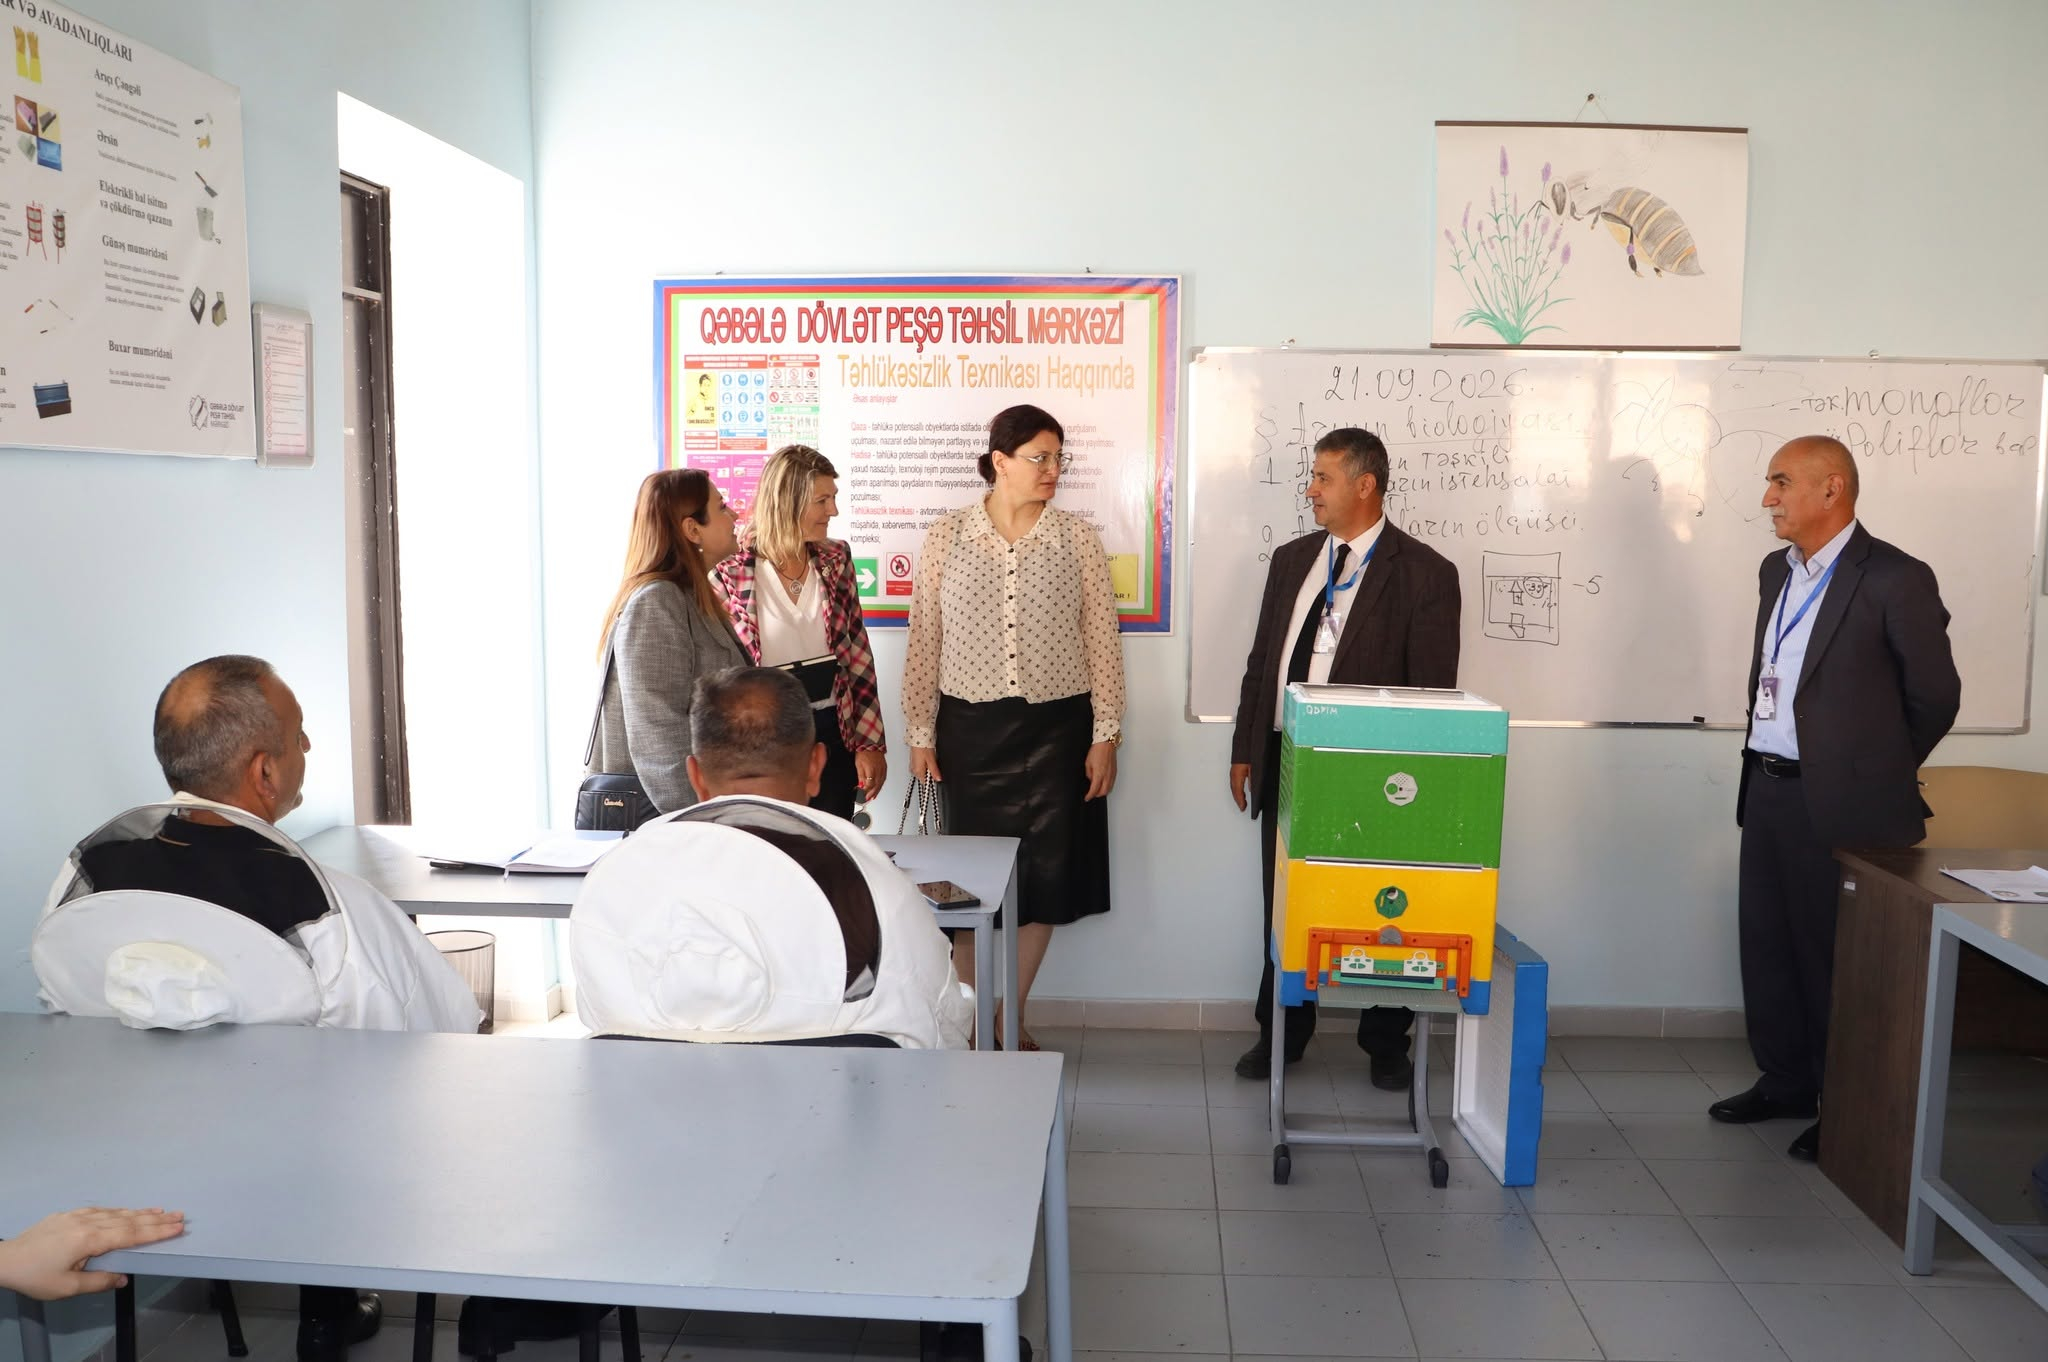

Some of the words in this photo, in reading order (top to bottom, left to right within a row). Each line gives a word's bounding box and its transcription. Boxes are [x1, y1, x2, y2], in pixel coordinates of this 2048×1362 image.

[39, 8, 133, 62] AVADANLIQLARI
[102, 234, 126, 253] Günəş
[108, 339, 130, 354] Buxar
[700, 306, 787, 346] QƏBƏLƏ
[797, 300, 882, 344] DÖVLƏT
[886, 306, 943, 353] PEŞƏ
[947, 300, 1023, 344] TƏHSİL
[1028, 301, 1124, 345] MƏRKƏZİ
[837, 354, 951, 388] Təhlükəsizlik
[957, 355, 1040, 388] Texnikası
[1047, 355, 1135, 397] Haqqında
